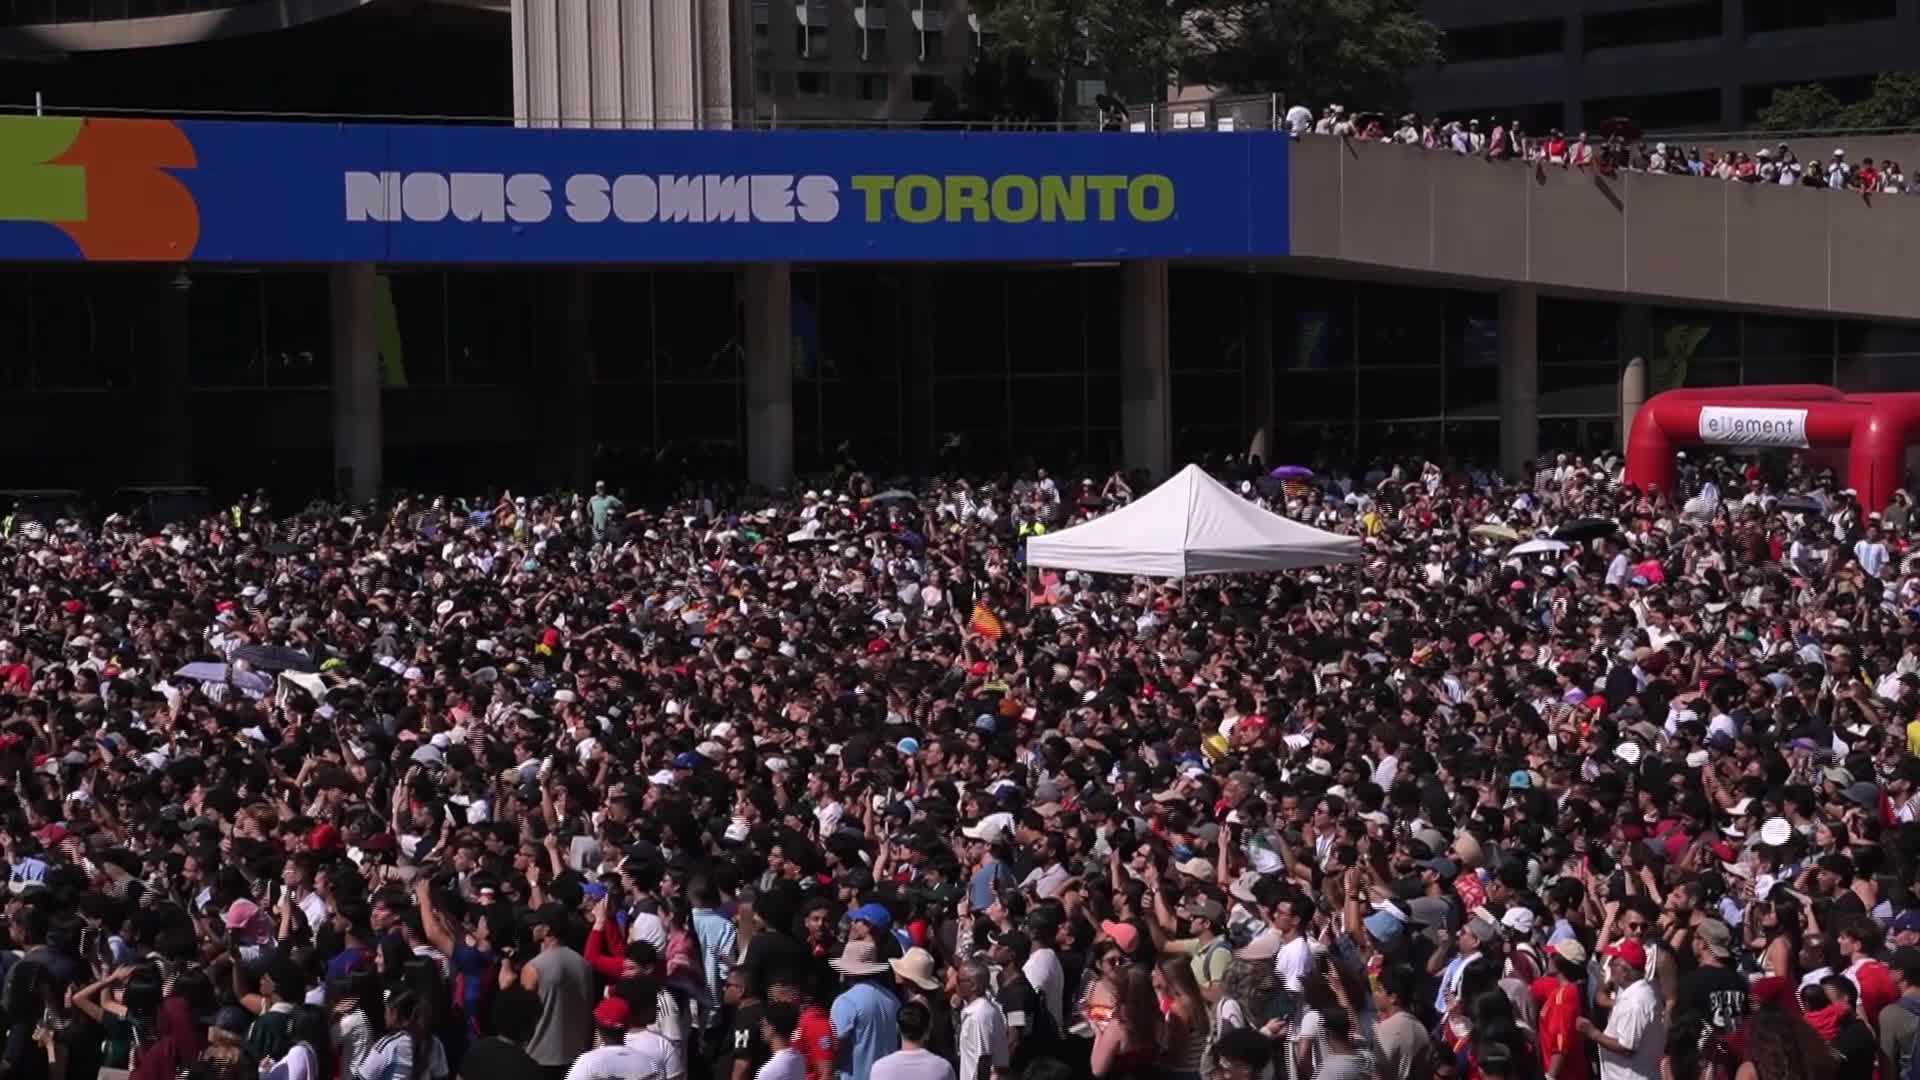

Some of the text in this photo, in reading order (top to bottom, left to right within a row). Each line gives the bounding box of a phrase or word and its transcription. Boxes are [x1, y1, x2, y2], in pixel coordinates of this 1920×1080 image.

[345, 171, 1174, 223] NOUS SOMMES TORONTO
